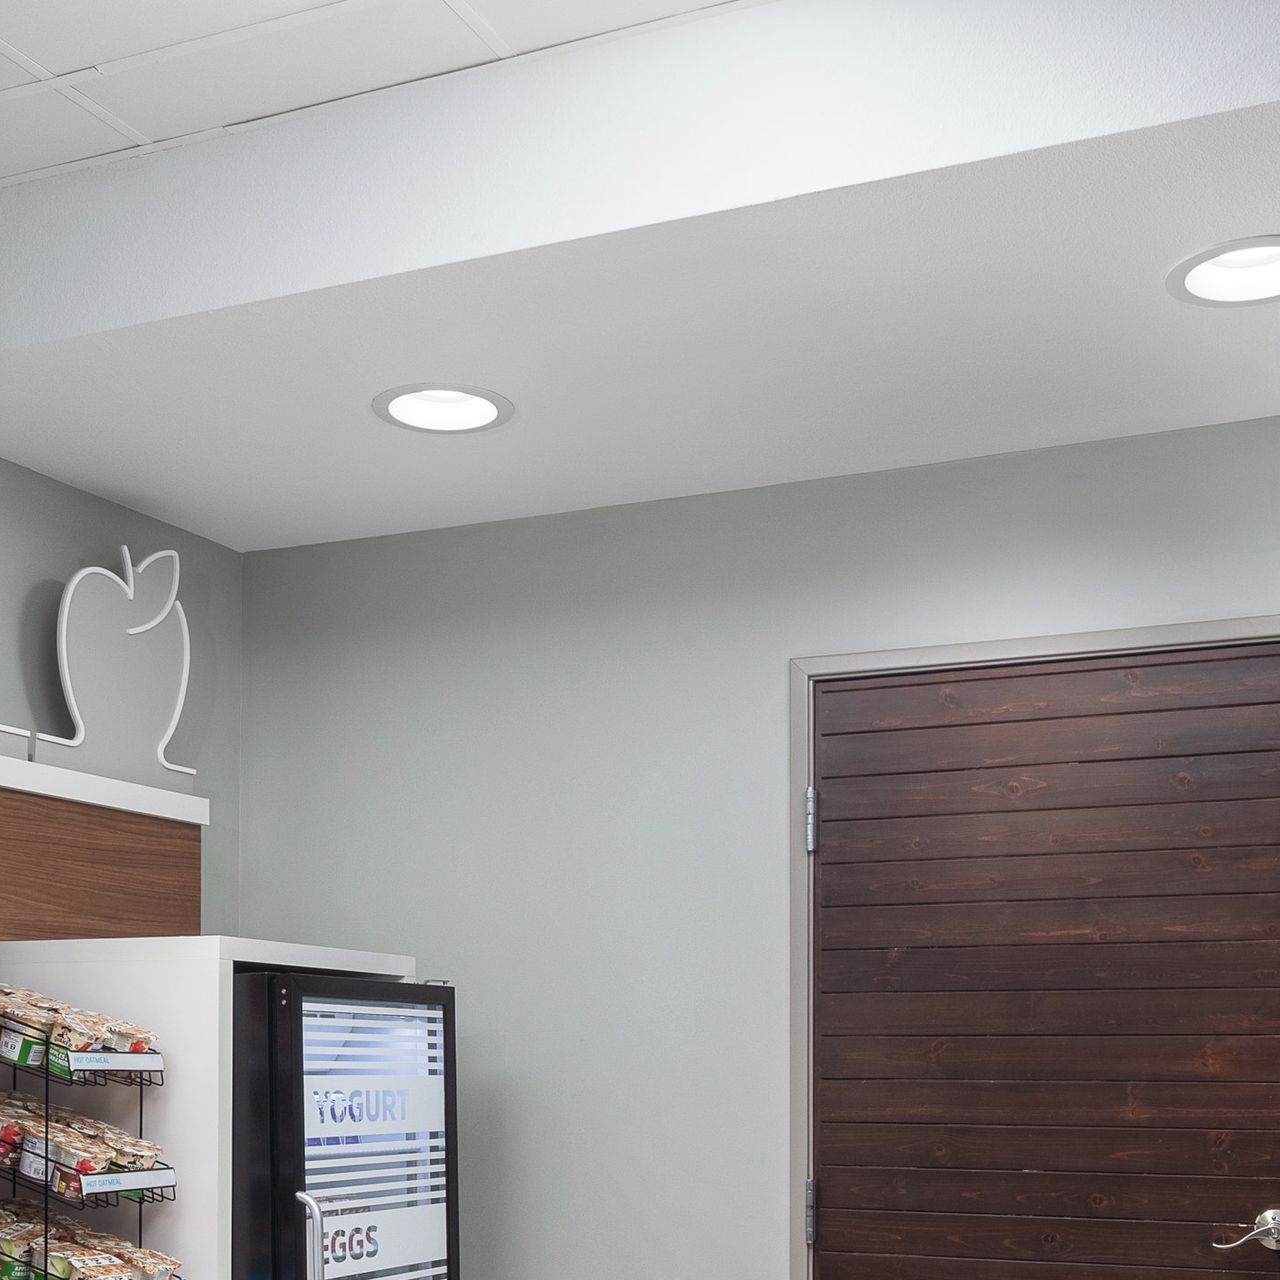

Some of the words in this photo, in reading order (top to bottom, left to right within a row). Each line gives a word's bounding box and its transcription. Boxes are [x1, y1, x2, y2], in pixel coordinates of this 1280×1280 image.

[73, 1056, 84, 1064] HOT
[85, 1056, 109, 1064] OATMEAL
[313, 1089, 410, 1124] YOGURT
[86, 1180, 97, 1188] HOT
[98, 1178, 122, 1186] OATMEAL
